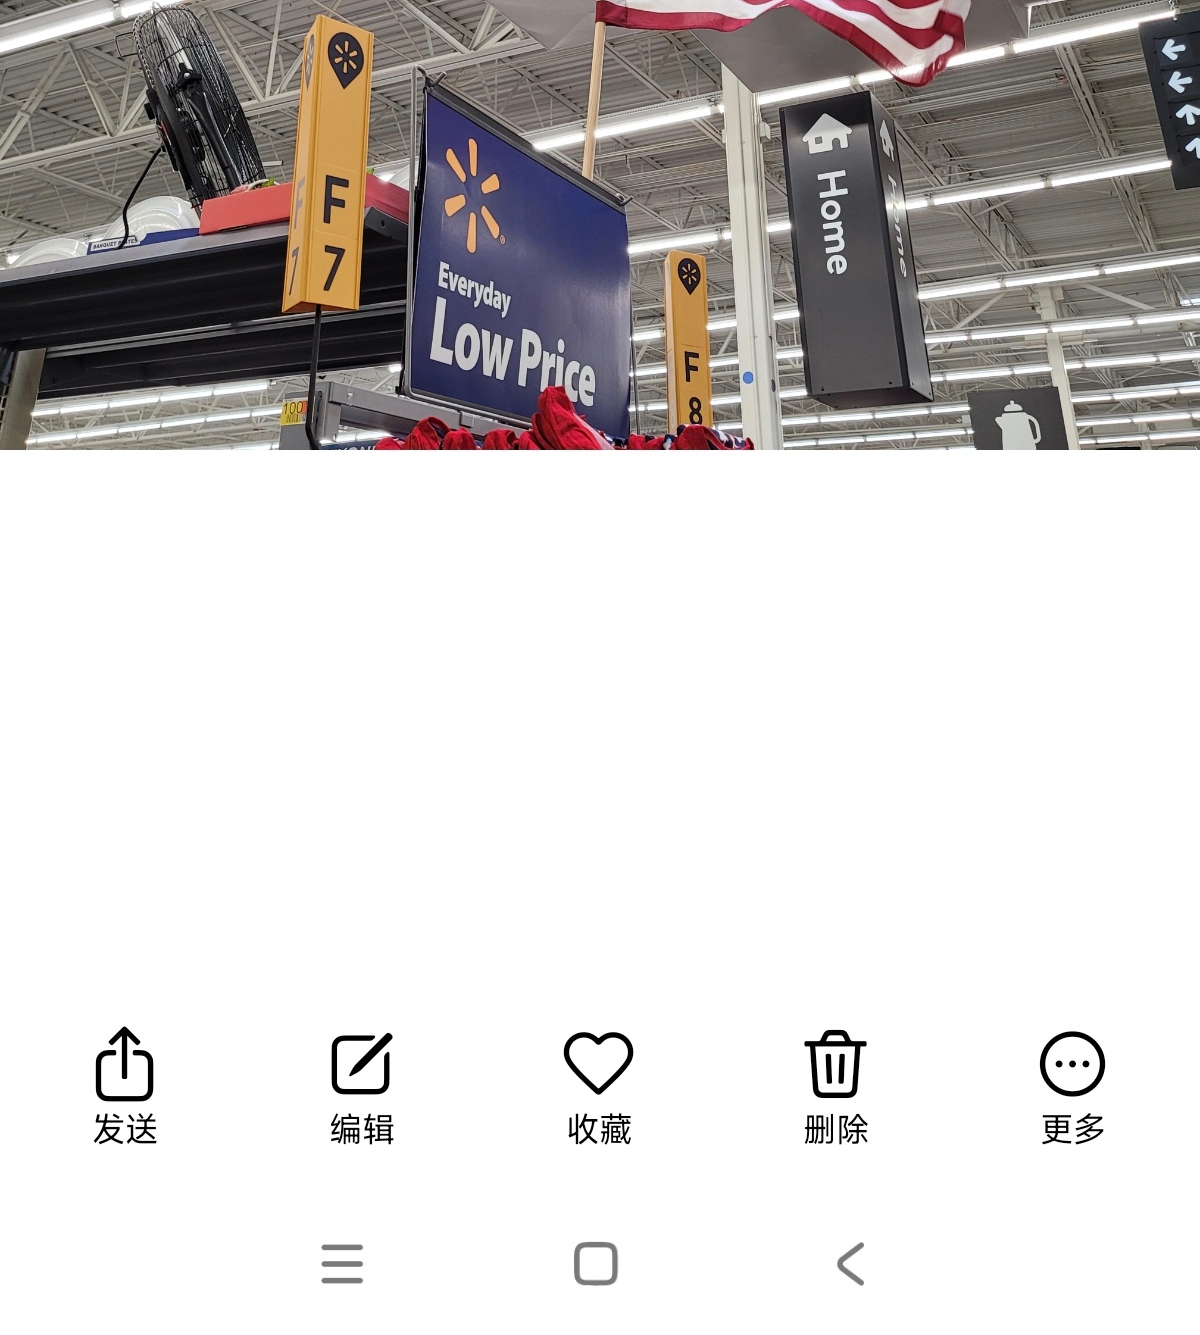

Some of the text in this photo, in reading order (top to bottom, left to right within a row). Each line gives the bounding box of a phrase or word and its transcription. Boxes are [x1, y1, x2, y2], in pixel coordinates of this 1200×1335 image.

[323, 174, 350, 224] F
[817, 170, 849, 275] Home
[323, 244, 346, 292] 7
[438, 261, 512, 319] Everyday
[430, 296, 596, 407] Low Price
[684, 351, 700, 383] F
[283, 400, 304, 415] 100
[688, 396, 703, 425] 8
